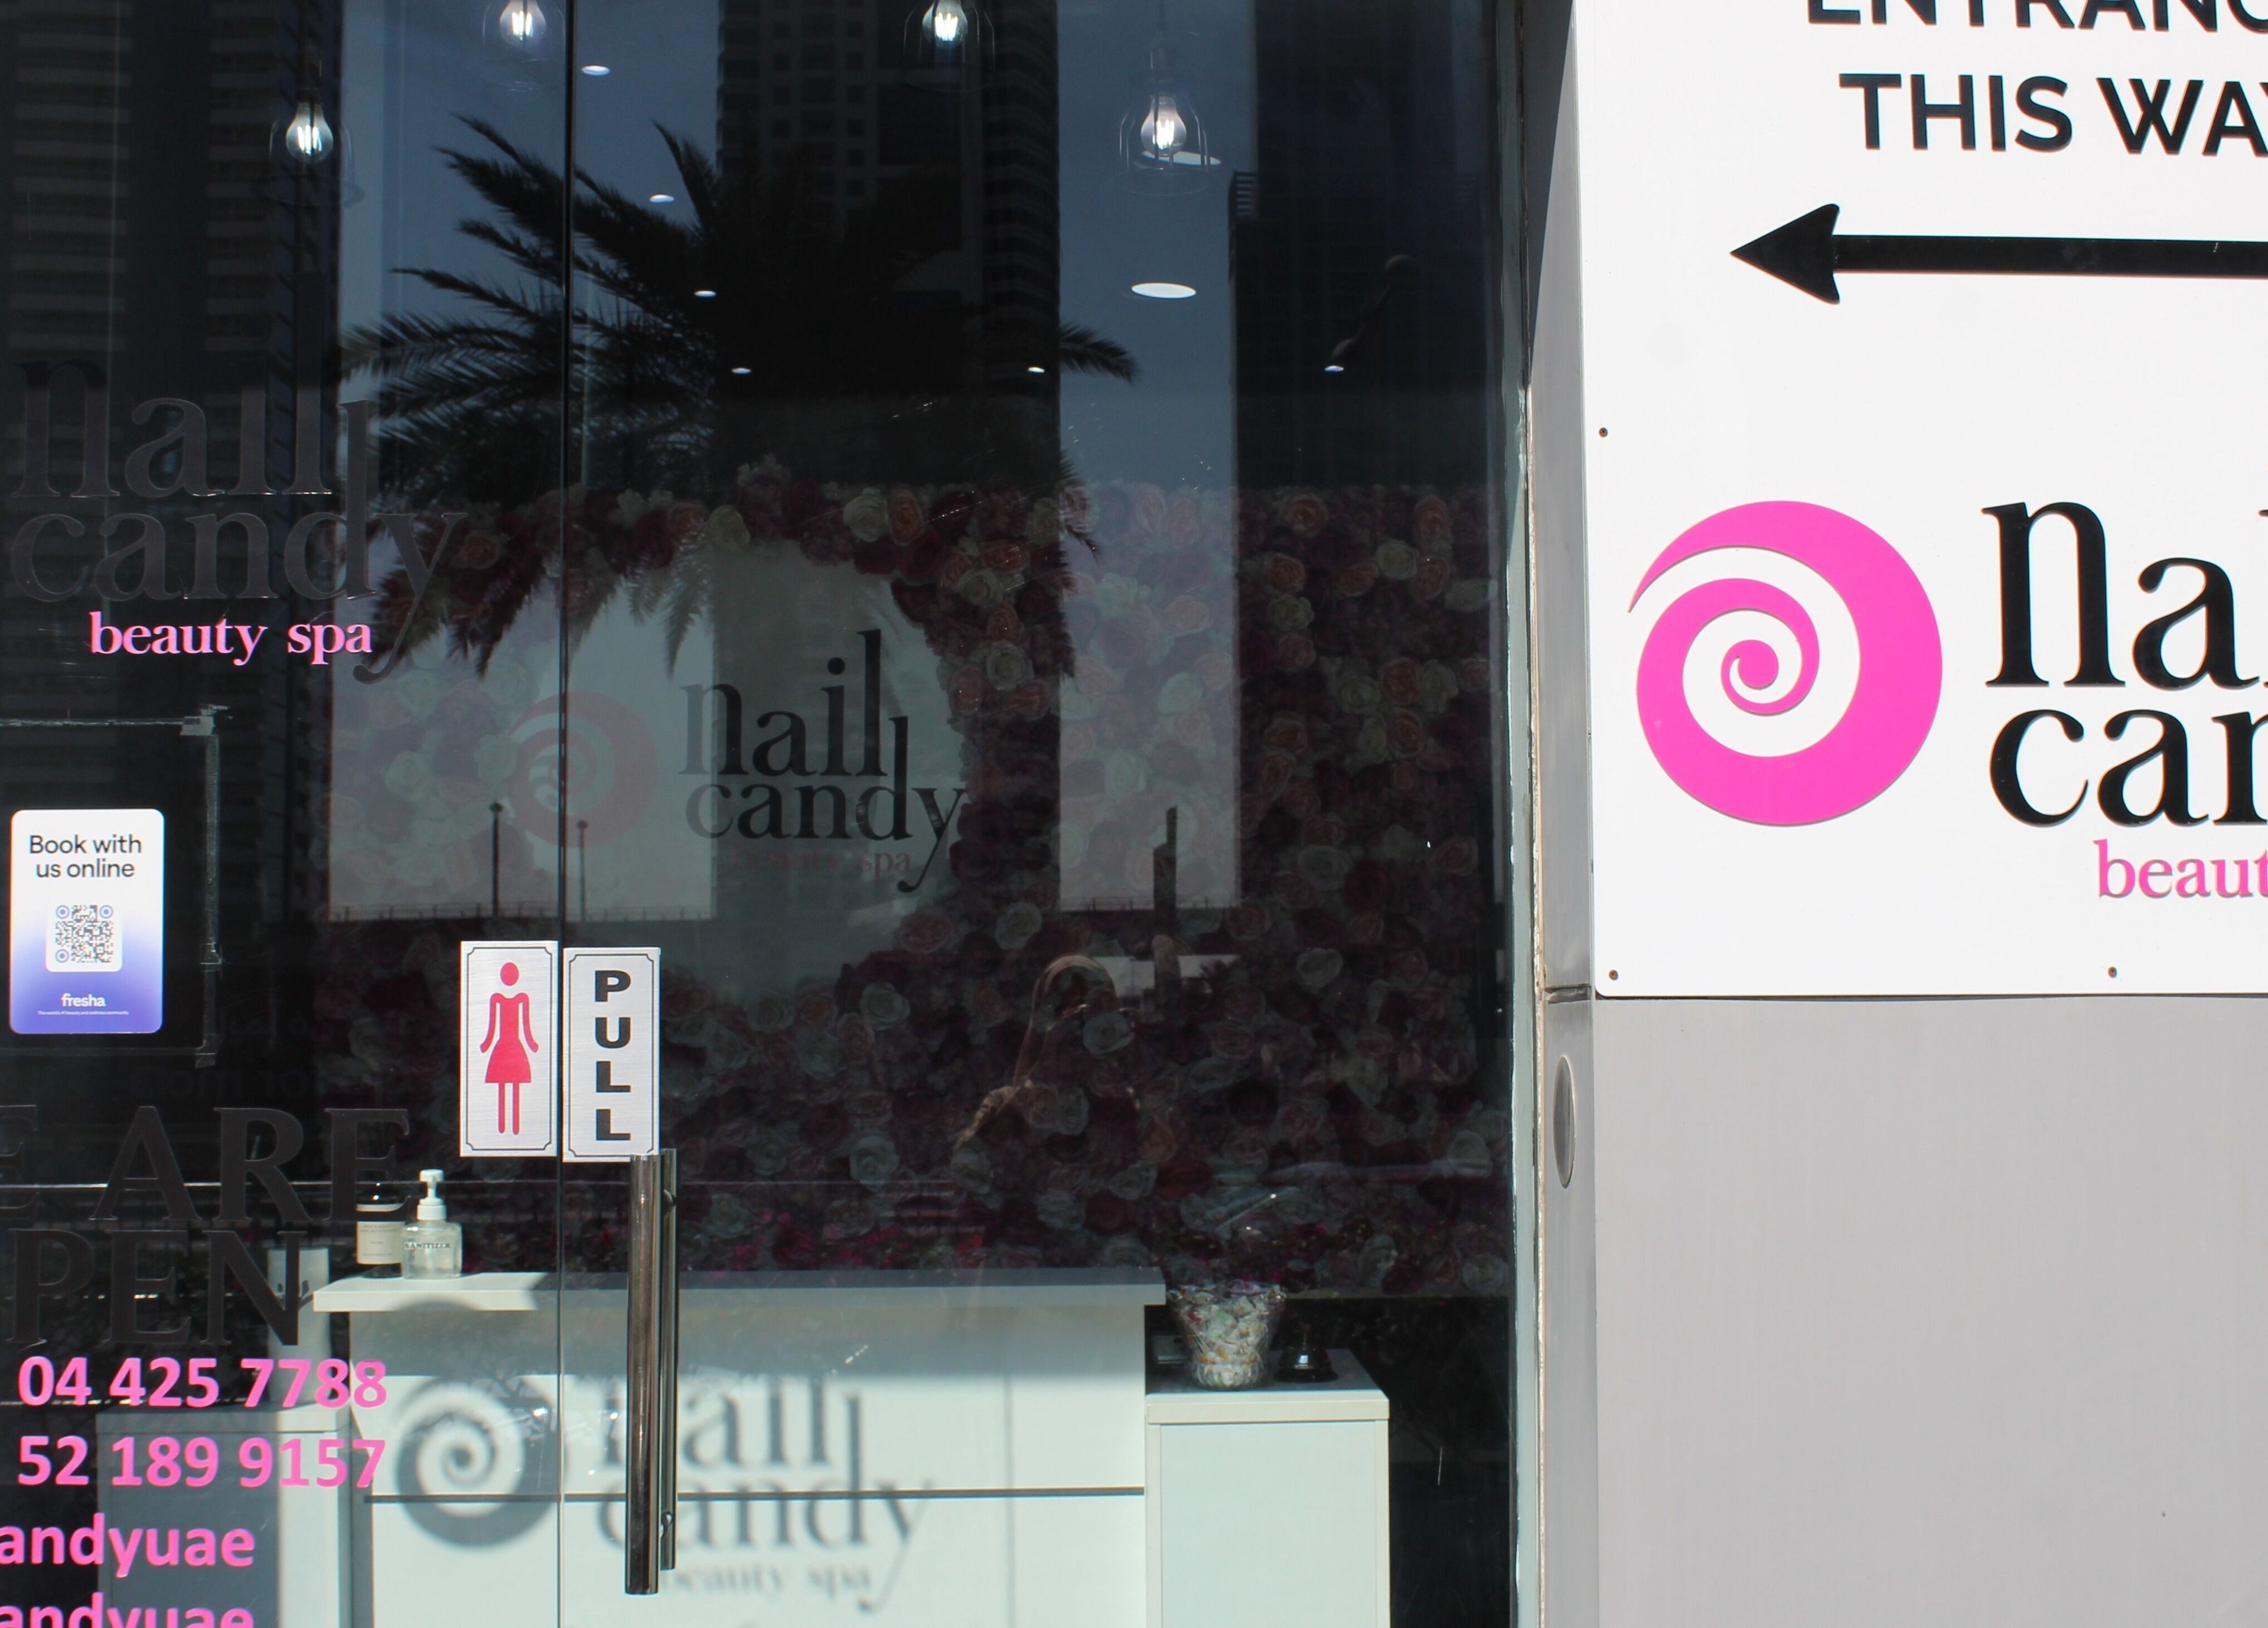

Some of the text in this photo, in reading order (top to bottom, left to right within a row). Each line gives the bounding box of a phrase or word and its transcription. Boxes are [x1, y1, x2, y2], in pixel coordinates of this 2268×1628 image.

[1839, 73, 2268, 157] THIS WA
[10, 271, 333, 497] nail
[10, 399, 467, 684] candy
[1982, 501, 2268, 691] na
[89, 611, 372, 666] beauty spa
[678, 629, 887, 777] nail
[30, 834, 142, 854] Book with
[685, 715, 966, 894] candy
[37, 858, 135, 878] us online
[61, 992, 106, 1007] fresha
[595, 970, 631, 1141] PULL
[89, 1105, 410, 1221] ARE
[5, 1229, 307, 1346] PEN
[18, 1356, 387, 1408] 04 425 7788
[18, 1435, 386, 1488] 52 189 9157
